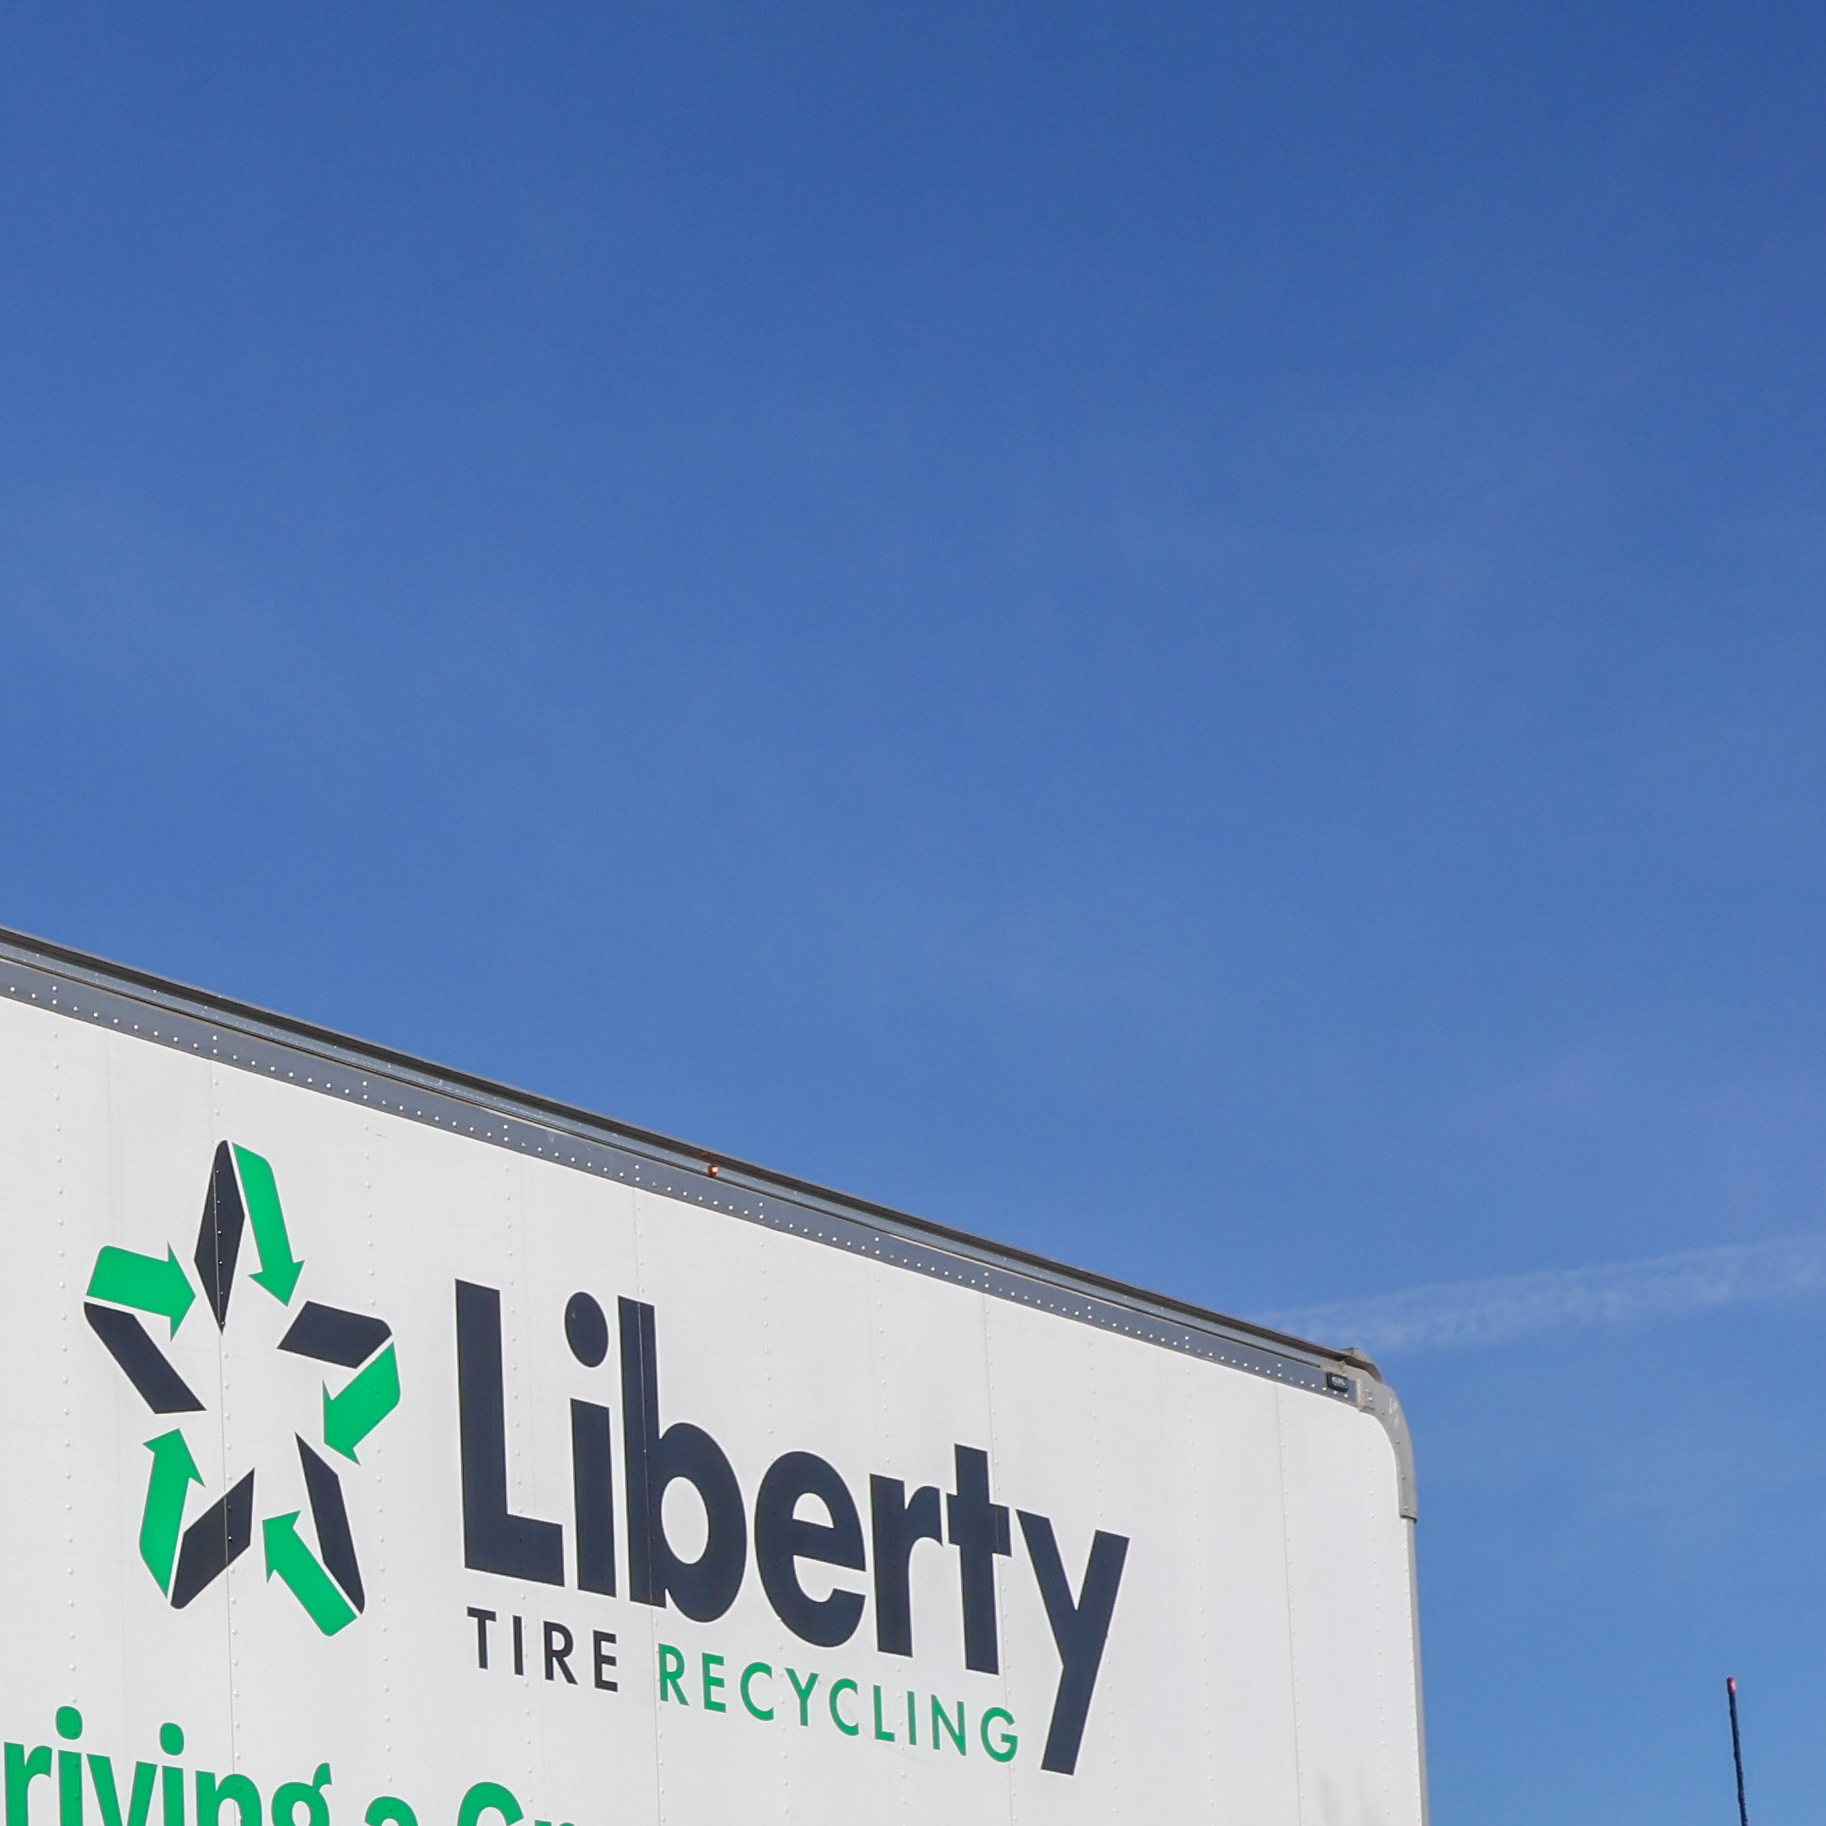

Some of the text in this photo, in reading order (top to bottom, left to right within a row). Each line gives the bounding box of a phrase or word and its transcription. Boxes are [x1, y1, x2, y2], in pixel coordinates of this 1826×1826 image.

[455, 1278, 1130, 1776] Liberty
[466, 1606, 1019, 1764] TIRE RECYCLING
